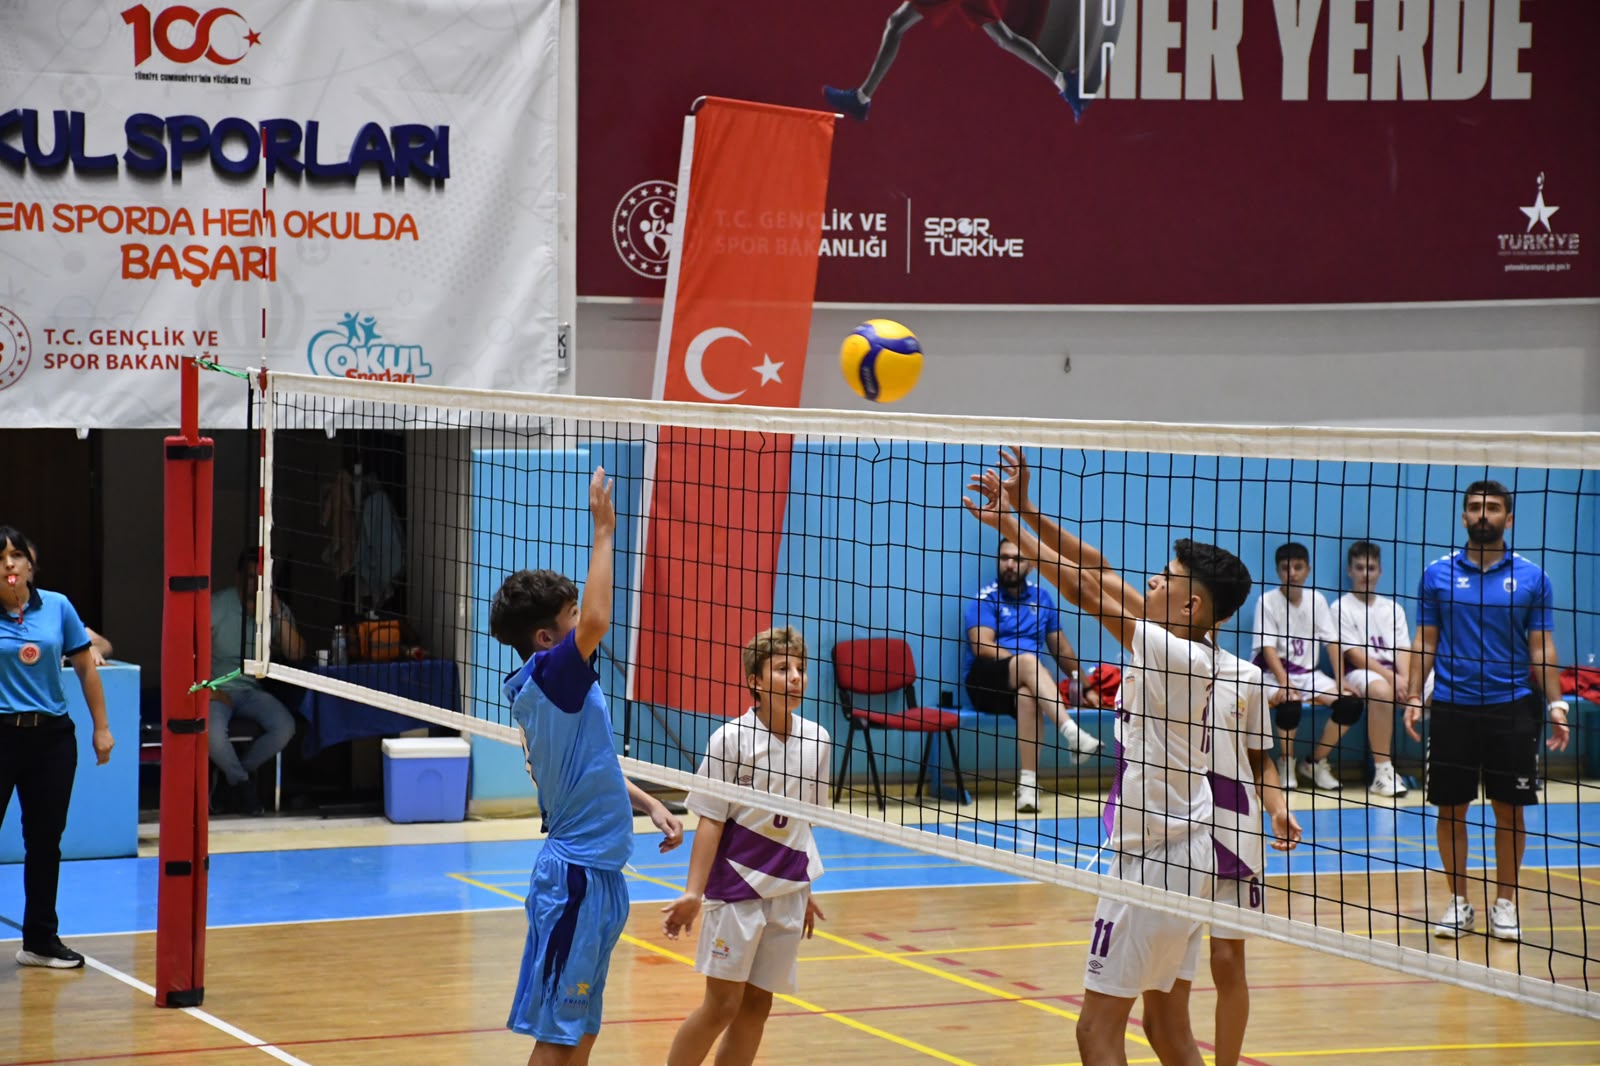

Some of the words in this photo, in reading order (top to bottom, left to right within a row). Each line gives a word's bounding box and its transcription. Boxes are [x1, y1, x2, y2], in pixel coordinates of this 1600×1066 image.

[1273, 0, 1533, 101] YERDE
[123, 112, 450, 182] SPORLARI
[52, 203, 195, 236] SPORDA
[202, 208, 277, 238] HEM
[283, 209, 419, 241] OKULDA
[860, 213, 887, 231] VE
[924, 234, 1024, 257] TÜRKİYE
[120, 243, 277, 288] BAŞARI
[43, 328, 81, 345] T.C.
[89, 327, 185, 350] GENÇLİK
[192, 330, 219, 347] VE
[43, 353, 100, 370] SPOR
[106, 351, 219, 370] BAKANĞI
[1249, 876, 1261, 908] 6
[1090, 918, 1115, 958] 11
